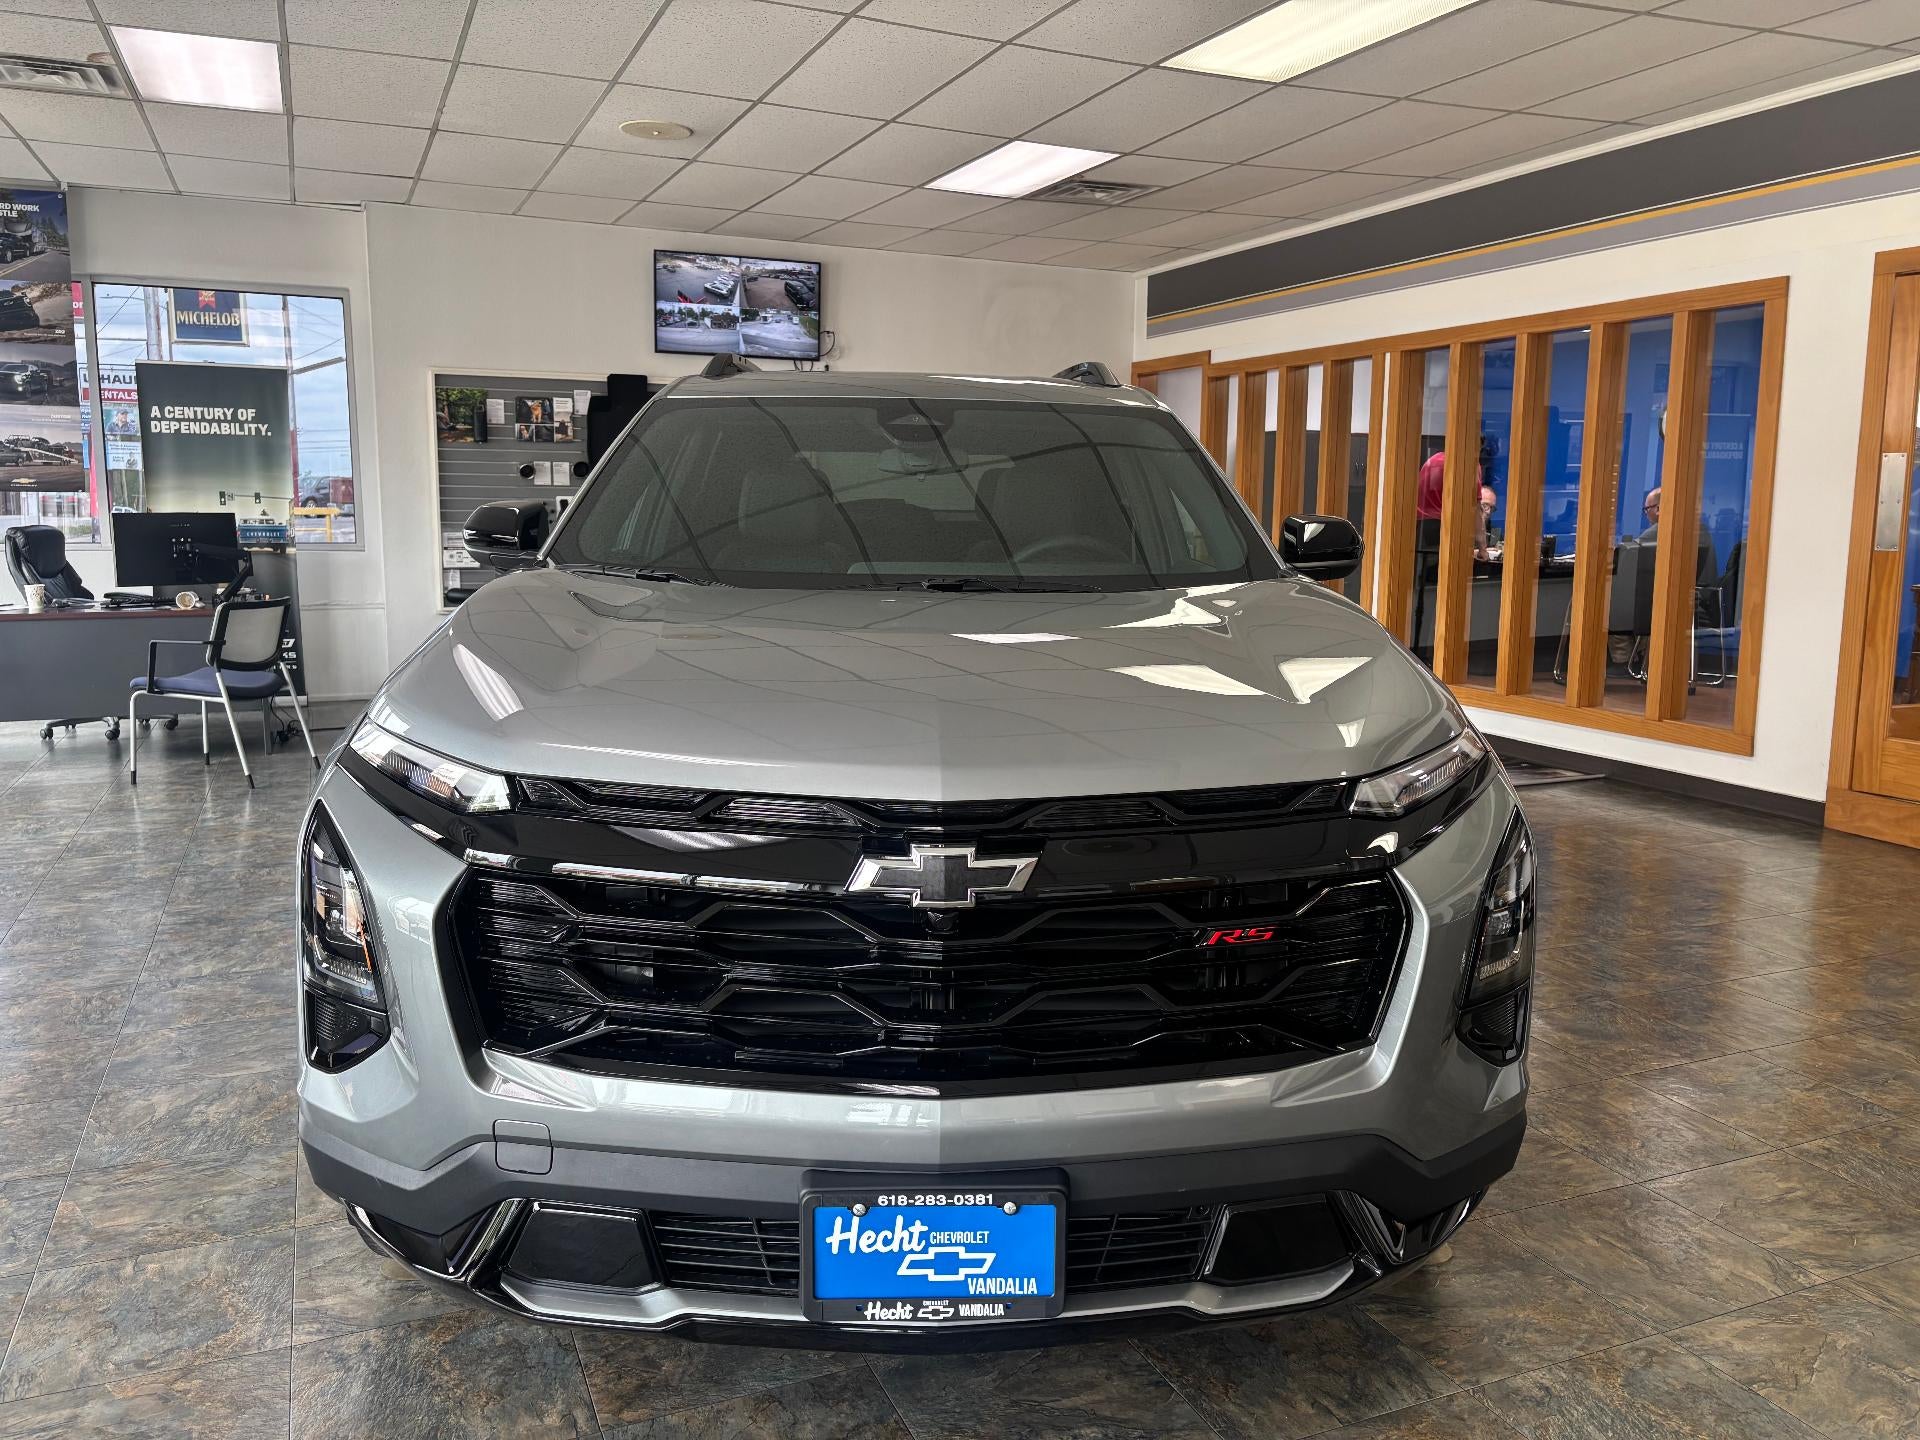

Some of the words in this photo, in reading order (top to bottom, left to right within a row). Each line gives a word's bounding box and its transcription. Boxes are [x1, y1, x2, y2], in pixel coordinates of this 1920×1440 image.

[12, 204, 40, 212] WORK
[176, 310, 240, 326] MICHELOB
[150, 405, 162, 418] A
[164, 406, 235, 420] CENTURY
[237, 408, 256, 421] OF
[150, 420, 272, 437] DEPENDABILITY.
[1207, 927, 1275, 945] RS
[877, 1193, 993, 1206] 618-283-0381
[825, 1214, 929, 1255] Hecht
[929, 1231, 990, 1244] CHEVROLET
[967, 1277, 1038, 1295] VANDALIA
[864, 1301, 914, 1320] Hecht
[958, 1303, 1005, 1317] VANDALIA
